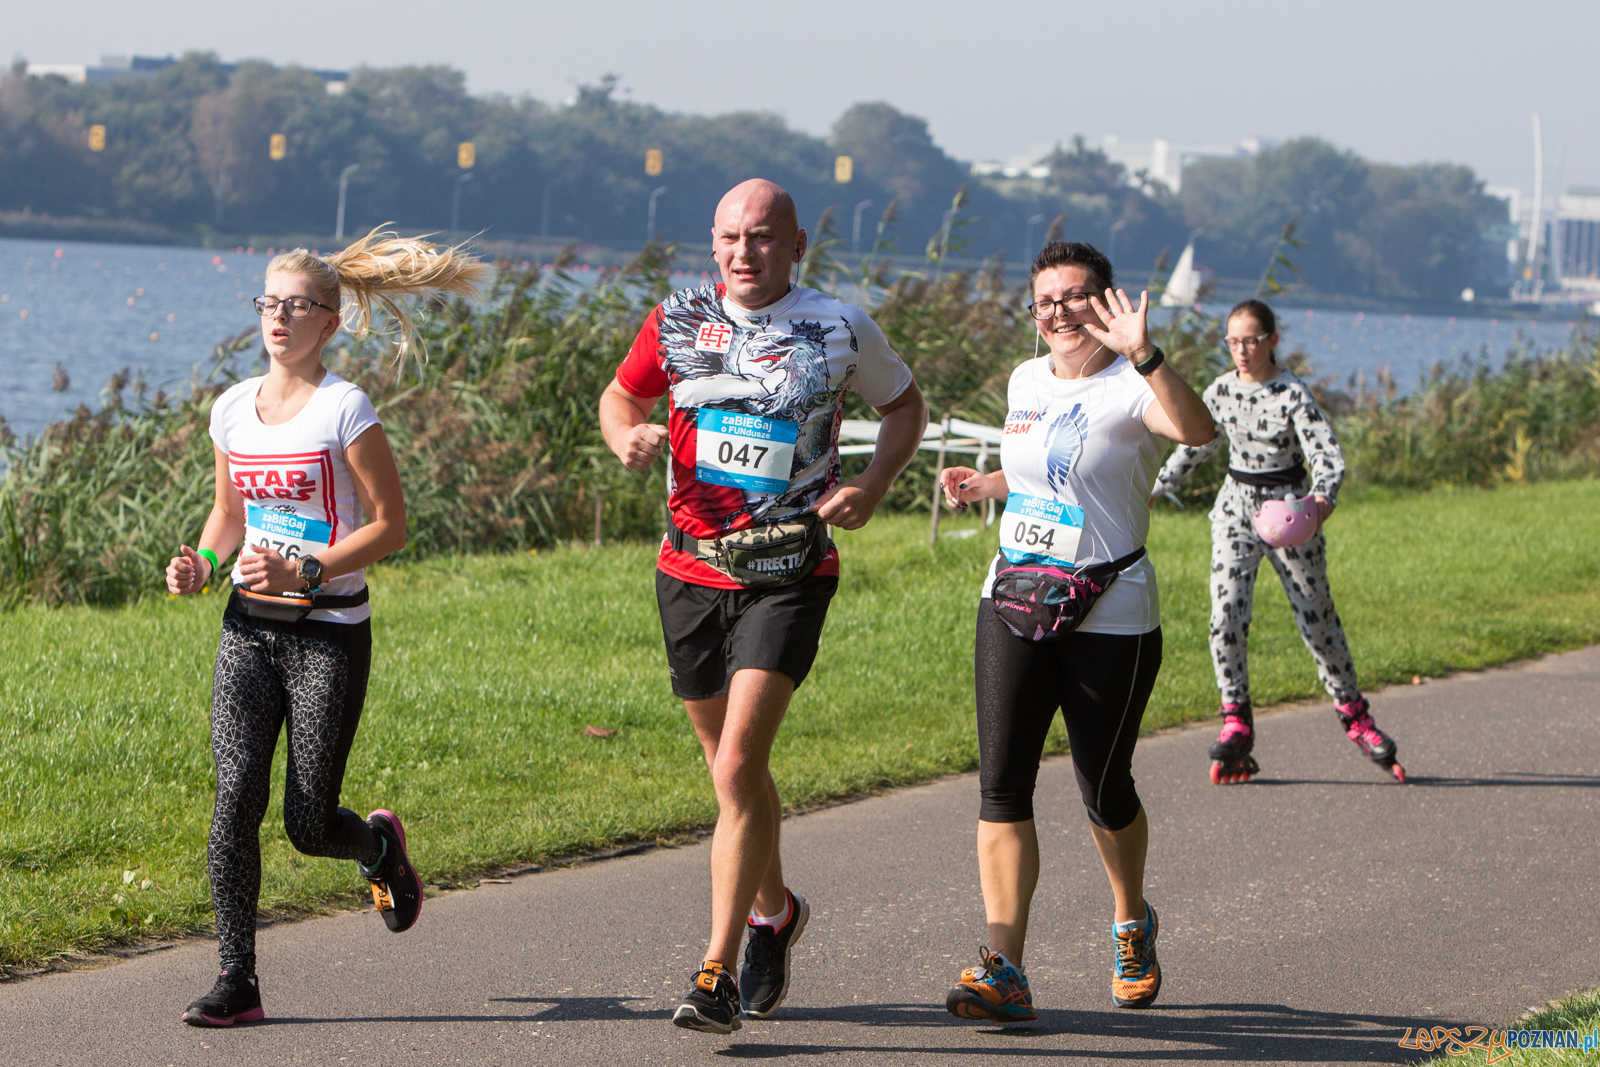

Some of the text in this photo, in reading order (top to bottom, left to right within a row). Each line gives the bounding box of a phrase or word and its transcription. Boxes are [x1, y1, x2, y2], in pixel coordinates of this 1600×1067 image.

[722, 415, 772, 433] zaBIEGaj
[728, 425, 771, 439] FUNdusze
[718, 440, 769, 469] 047
[233, 470, 316, 488] STAR
[1022, 499, 1064, 516] zaBIEGaj
[1025, 509, 1061, 522] FUNdusze
[262, 513, 307, 531] zaBIEGaj
[266, 524, 304, 538] FUNdusze
[1014, 521, 1056, 550] 054
